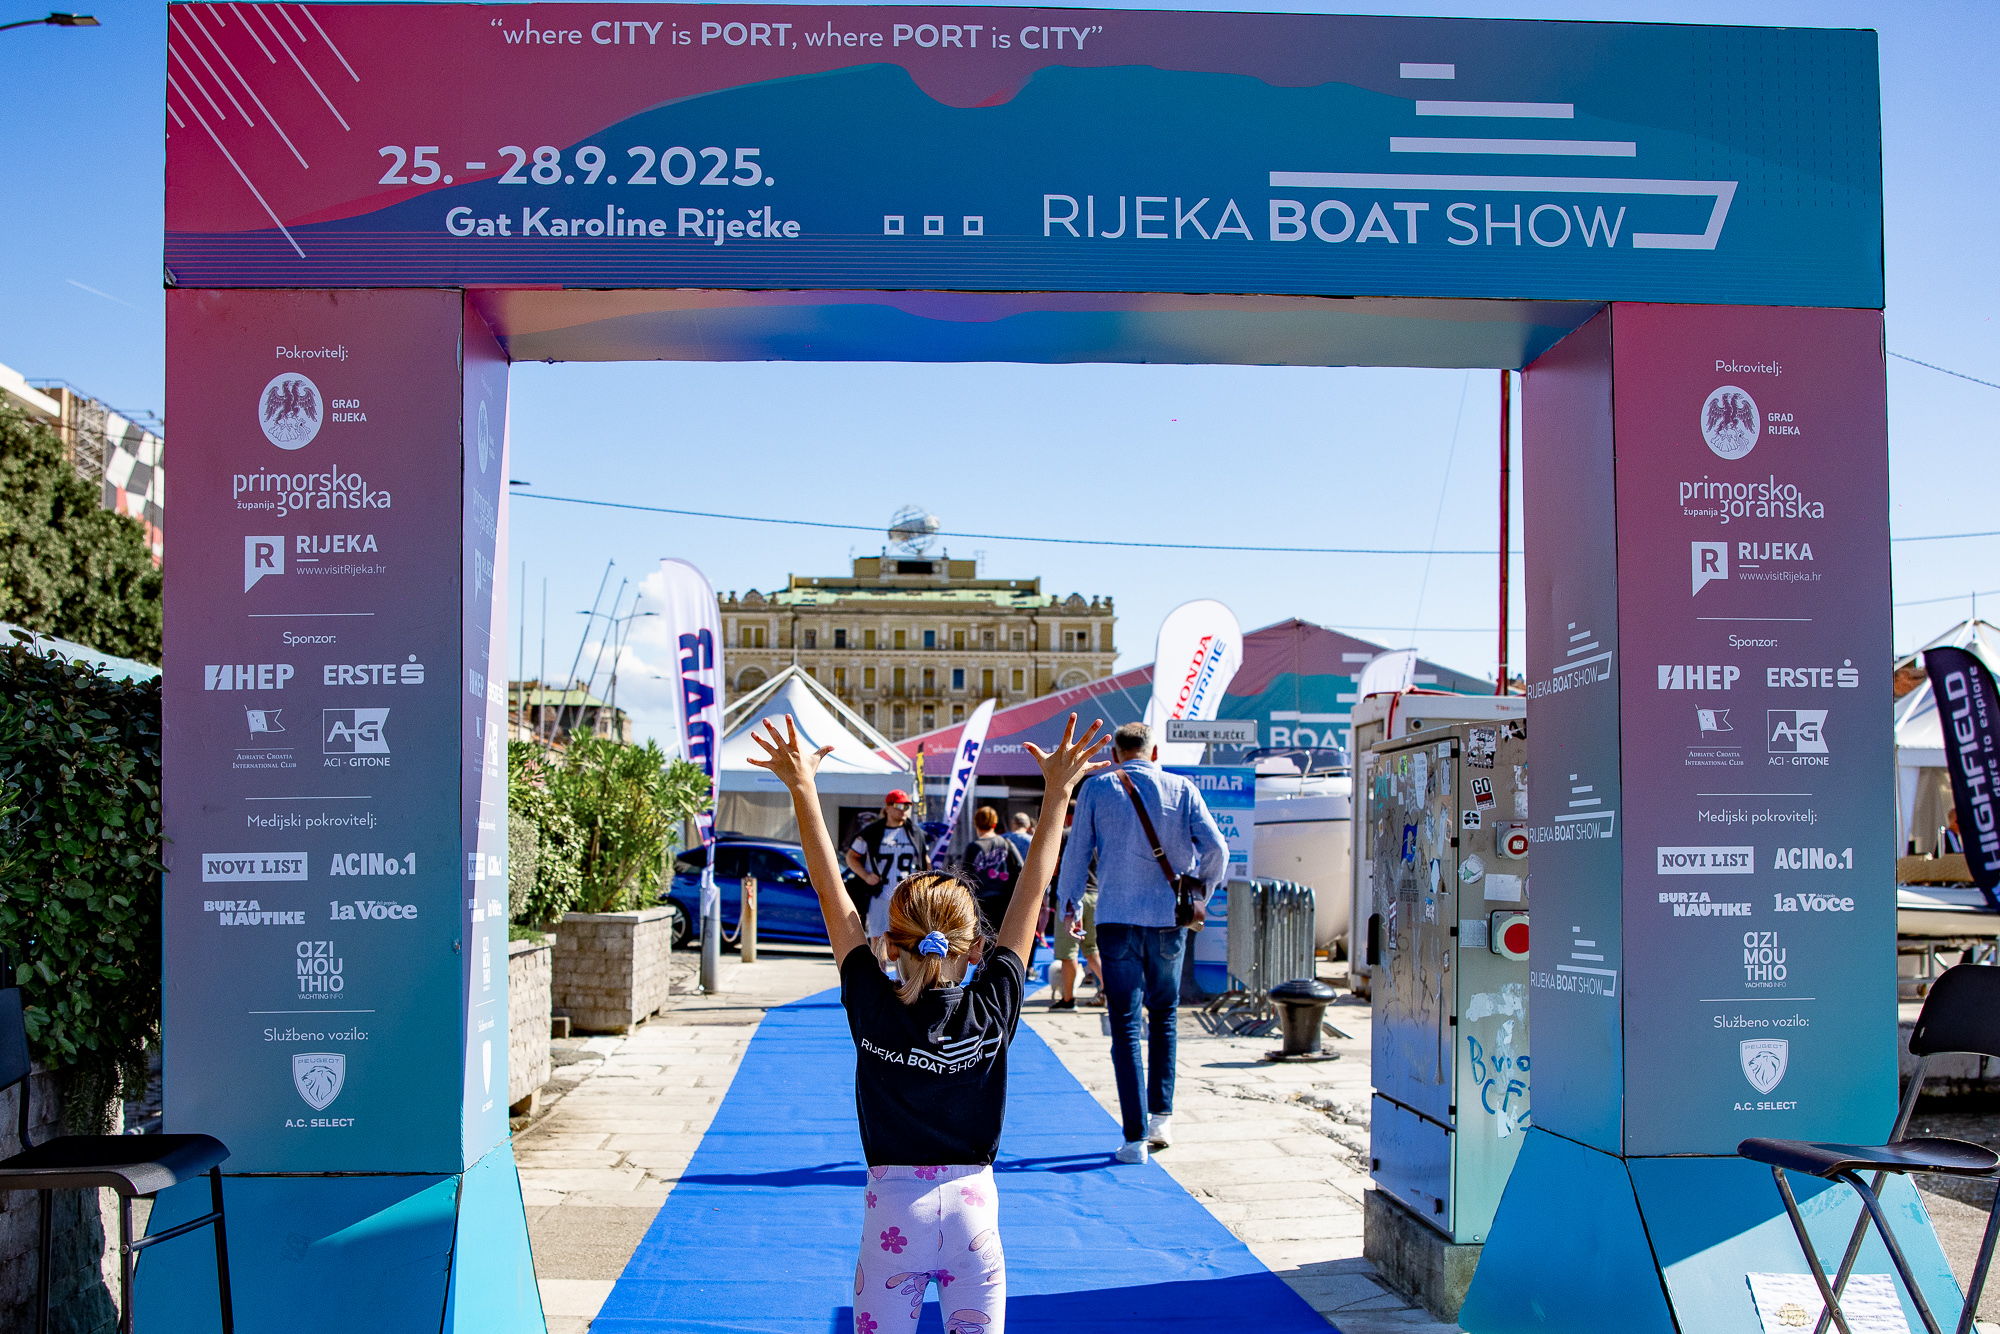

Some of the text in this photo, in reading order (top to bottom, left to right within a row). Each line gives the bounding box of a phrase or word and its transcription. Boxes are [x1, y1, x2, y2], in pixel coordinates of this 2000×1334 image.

[590, 20, 664, 45] CITY
[671, 22, 692, 46] is
[700, 21, 797, 50] PORT,
[804, 21, 884, 47] where
[892, 23, 984, 48] PORT
[991, 26, 1011, 49] is
[378, 145, 453, 186] 25.
[445, 204, 801, 246] Gat Karoline Riječke
[1043, 193, 1627, 248] RIJEKA BOAT SHOW
[275, 345, 349, 362] Pokrovitelj:
[1715, 359, 1783, 377] Pokrovitelj:
[331, 399, 360, 409] GRAD
[331, 412, 368, 423] RIJEKA
[1767, 412, 1794, 423] GRAD
[1768, 425, 1801, 436] RIJEKA
[233, 464, 362, 500] primorsko
[1679, 474, 1798, 506] primorsko
[236, 481, 392, 518] županija goranska
[1683, 492, 1826, 525] županija goranska
[296, 534, 379, 554] RIJEKA
[1738, 542, 1814, 561] RIJEKA
[296, 562, 387, 577] www.visitRijeka.hr
[1738, 571, 1822, 584] www.visitRijeka.hr
[282, 631, 337, 648] Sponzor:
[1728, 634, 1778, 650] Sponzor:
[235, 663, 295, 690] HEP
[323, 663, 397, 686] ERSTE
[1171, 634, 1214, 720] HONDA
[1527, 665, 1598, 701] RIJEKA BOAT SHOW
[1686, 665, 1741, 690] HEP
[1767, 667, 1834, 688] ERSTE
[1968, 664, 1988, 729] explore
[1172, 728, 1246, 740] KAROLINE RIJEČKE
[323, 758, 341, 768] ACI
[349, 757, 391, 767] GITONE
[1768, 757, 1784, 766] ACI
[1791, 757, 1830, 766] GITONE
[1944, 671, 2000, 872] HIGHFIELD
[1472, 777, 1491, 795] GO
[247, 812, 378, 831] Medijski pokrovitelj:
[1698, 808, 1818, 826] Medijski pokrovitelj:
[1529, 822, 1601, 843] RIJEKA BOAT SHOW
[207, 859, 303, 876] NOVI LIST
[1661, 853, 1749, 868] NOVI LIST
[203, 900, 261, 912] BURZA
[1658, 892, 1711, 904] BURZA
[219, 911, 306, 926] NAUTIKE
[1673, 902, 1752, 917] NAUTIKE
[1743, 947, 1787, 965] MOU
[296, 958, 344, 976] MOU
[1744, 964, 1788, 981] THIO
[297, 975, 345, 993] THIO
[1530, 971, 1604, 996] RIJEKA BOAT SHOW
[329, 992, 344, 1000] INFO
[1713, 1013, 1810, 1029] Službeno vozilo:
[263, 1026, 369, 1042] Službeno vozilo:
[297, 1057, 341, 1065] PEUGEOT
[861, 1038, 984, 1075] RIJEKA BOAT SHOW
[1733, 1101, 1798, 1112] A.C. SELECT
[284, 1117, 355, 1128] A.C. SELECT
